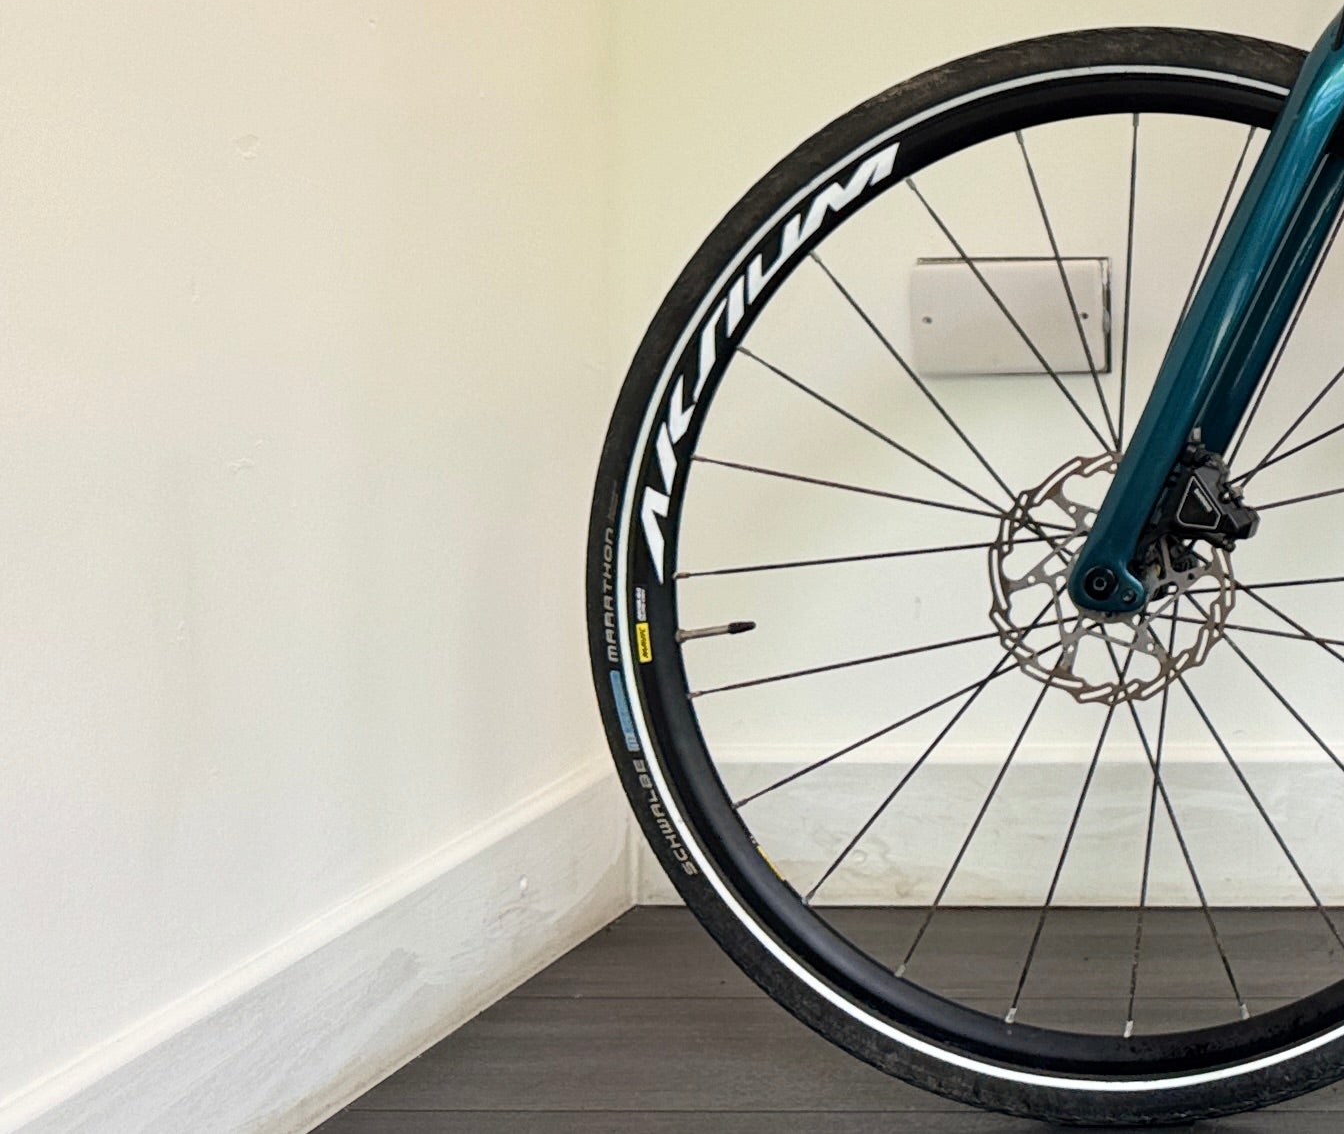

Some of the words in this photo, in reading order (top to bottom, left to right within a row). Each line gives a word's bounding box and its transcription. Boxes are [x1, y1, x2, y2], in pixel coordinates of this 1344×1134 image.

[640, 142, 900, 585] AKSIUM
[602, 527, 619, 663] MARATHON
[632, 758, 700, 877] SCHWALBE
